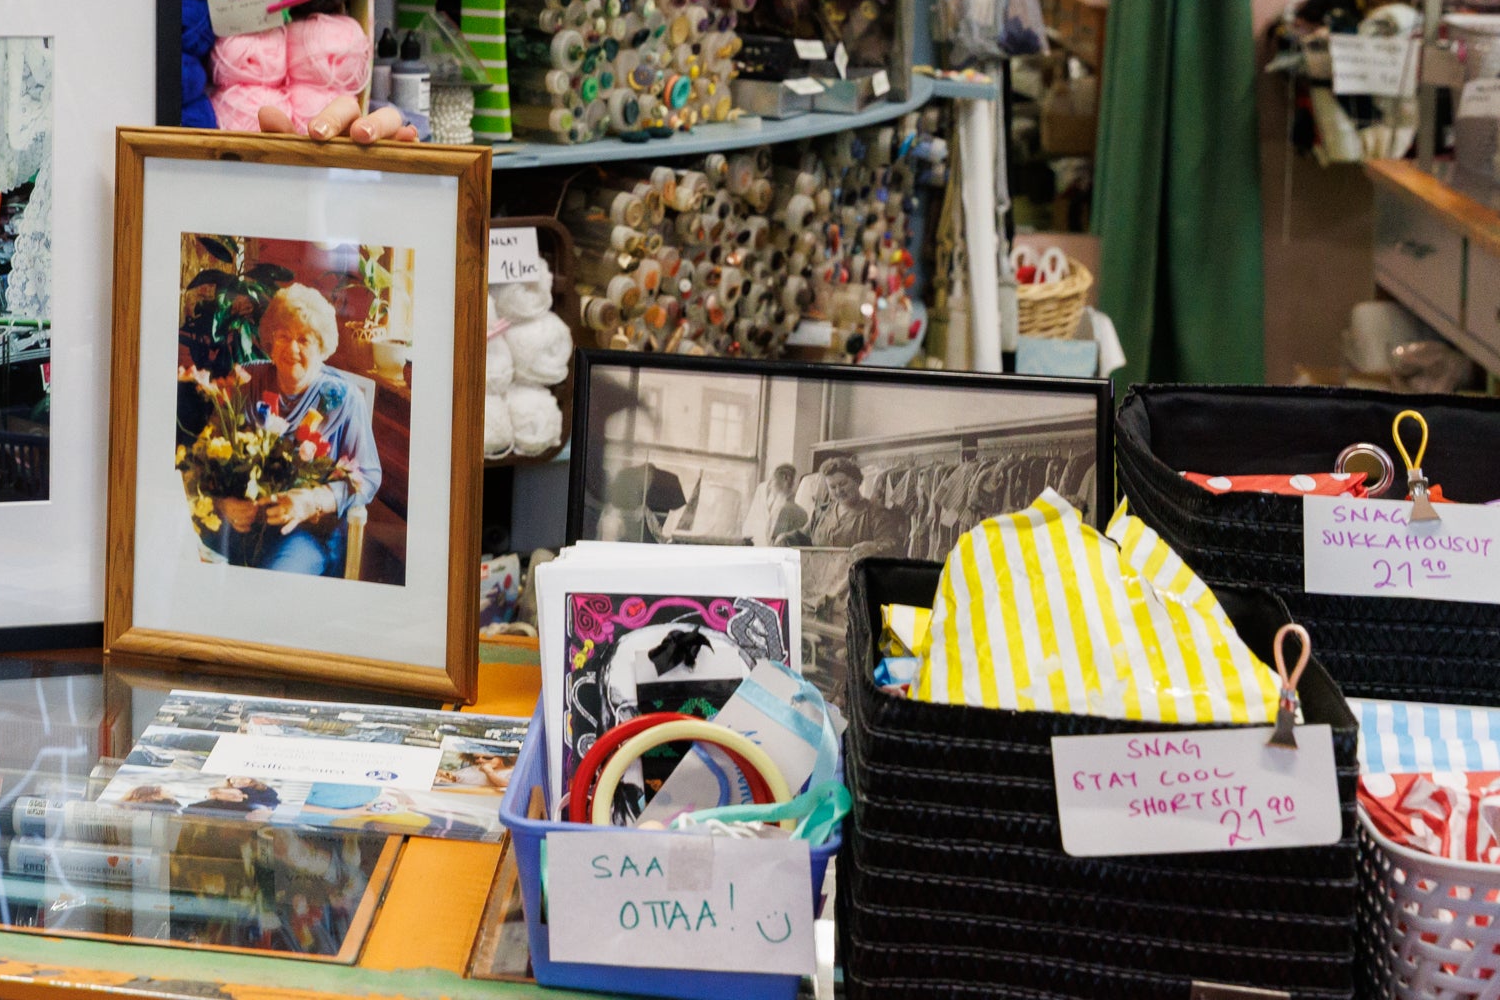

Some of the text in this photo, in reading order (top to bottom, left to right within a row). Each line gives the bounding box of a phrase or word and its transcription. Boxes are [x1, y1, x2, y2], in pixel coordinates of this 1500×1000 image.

[1332, 505, 1408, 527] SNAG
[1322, 530, 1493, 557] SUKKAHOUSUT
[1126, 738, 1202, 759] SNAG
[1072, 768, 1235, 791] STAY COOL
[1128, 786, 1248, 818] SHORTSIT
[591, 855, 664, 879] SAA
